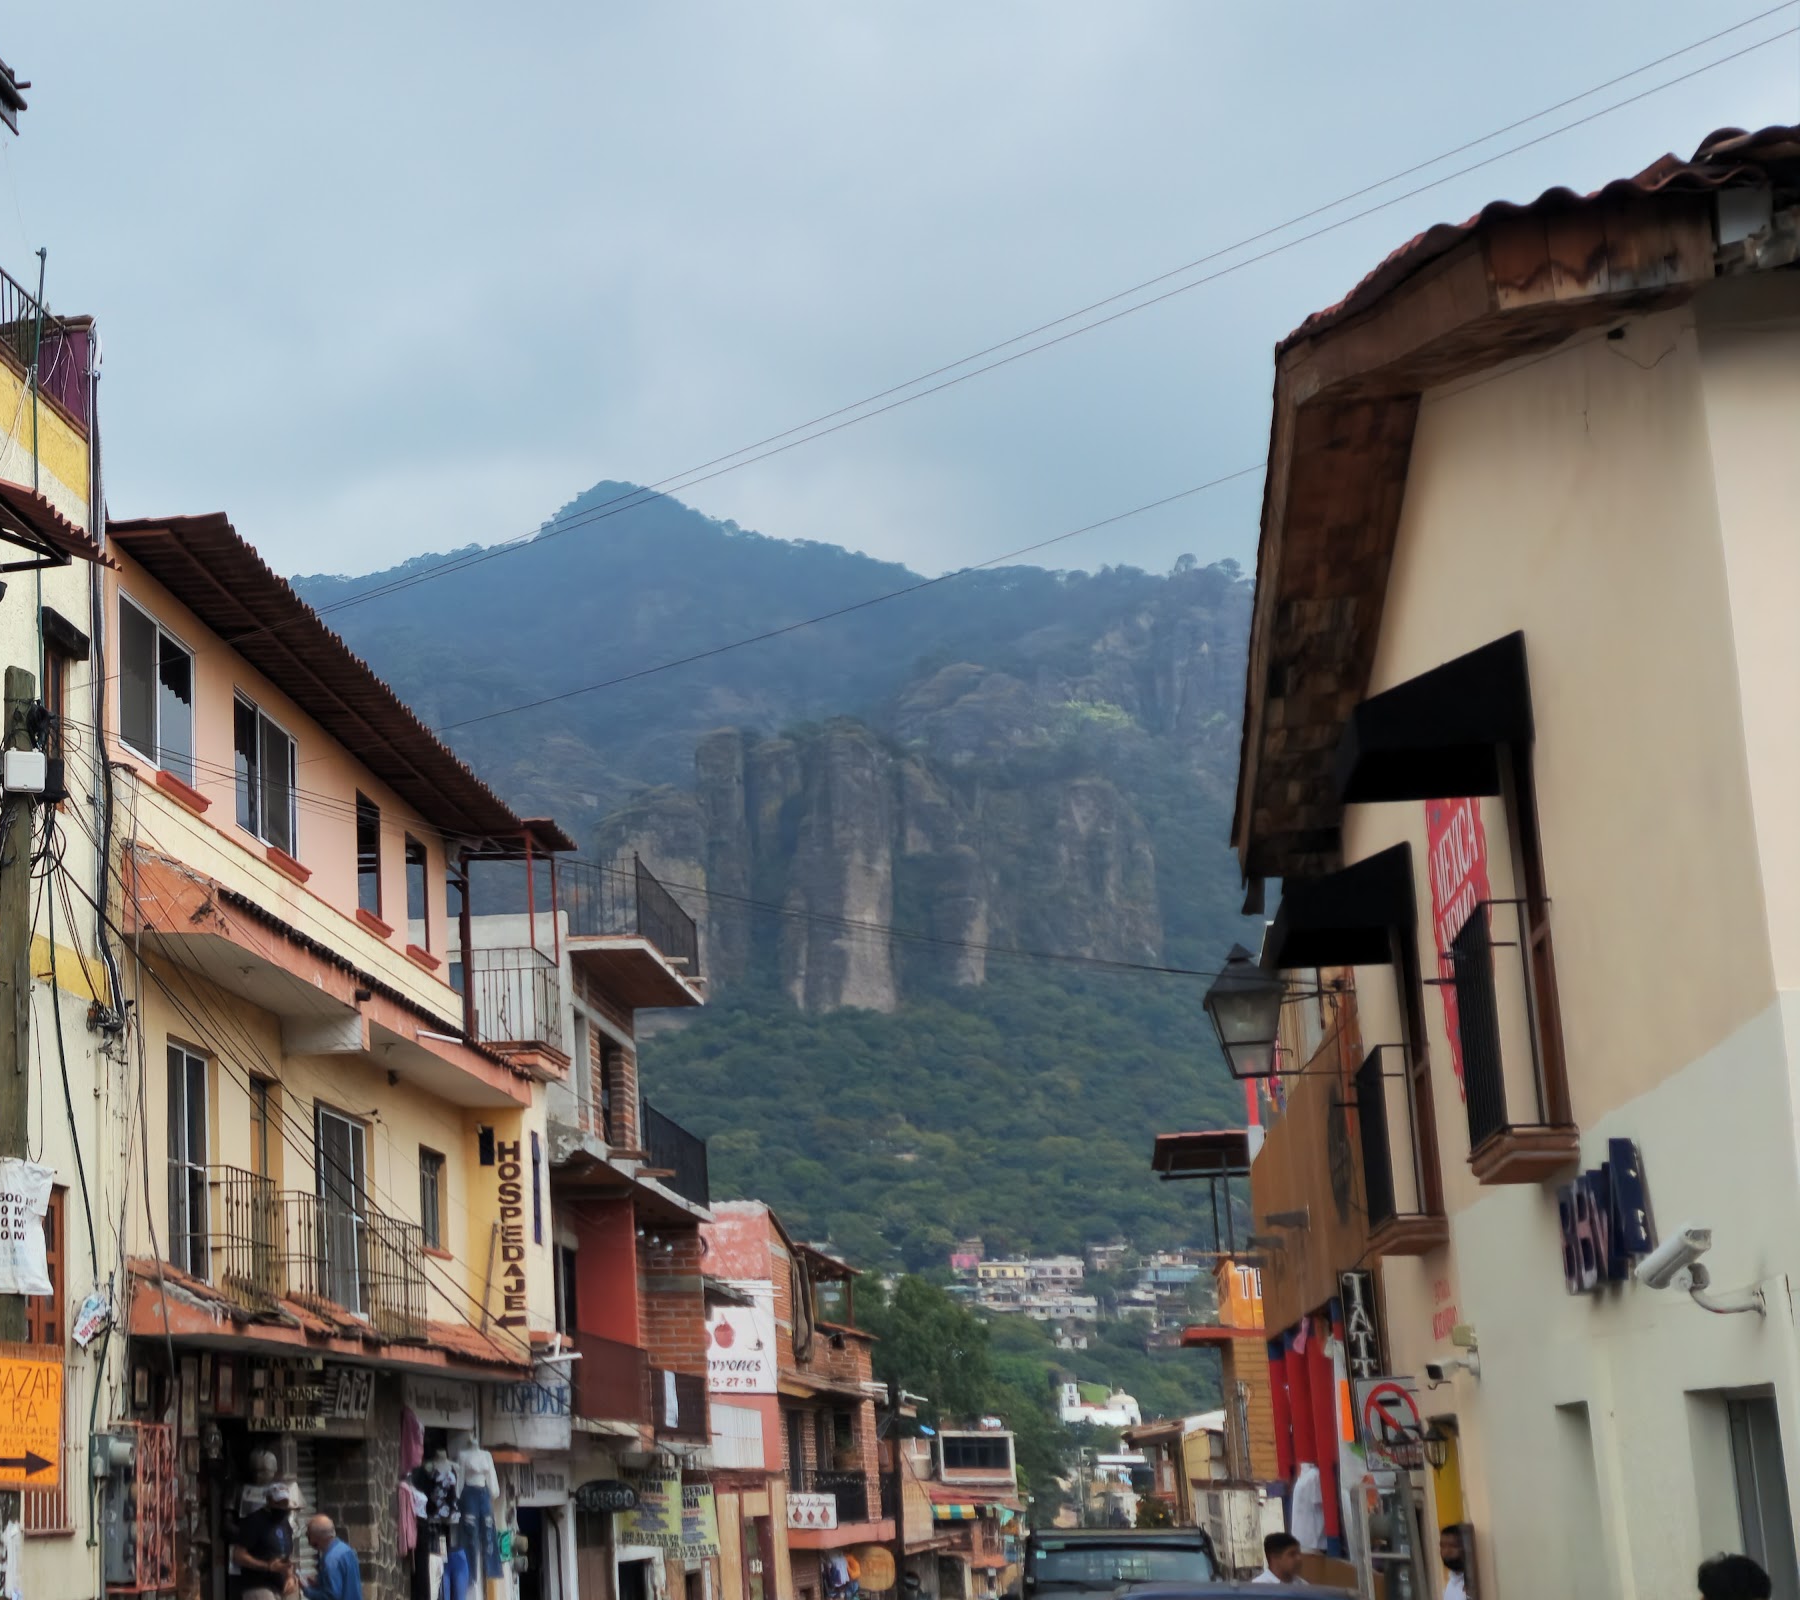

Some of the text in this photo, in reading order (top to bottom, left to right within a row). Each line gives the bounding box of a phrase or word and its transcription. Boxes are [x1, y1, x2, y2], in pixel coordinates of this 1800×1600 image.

[1434, 797, 1479, 915] MEXICA
[497, 1140, 527, 1312] HOSPEDAJE
[1342, 1272, 1378, 1379] TATT
